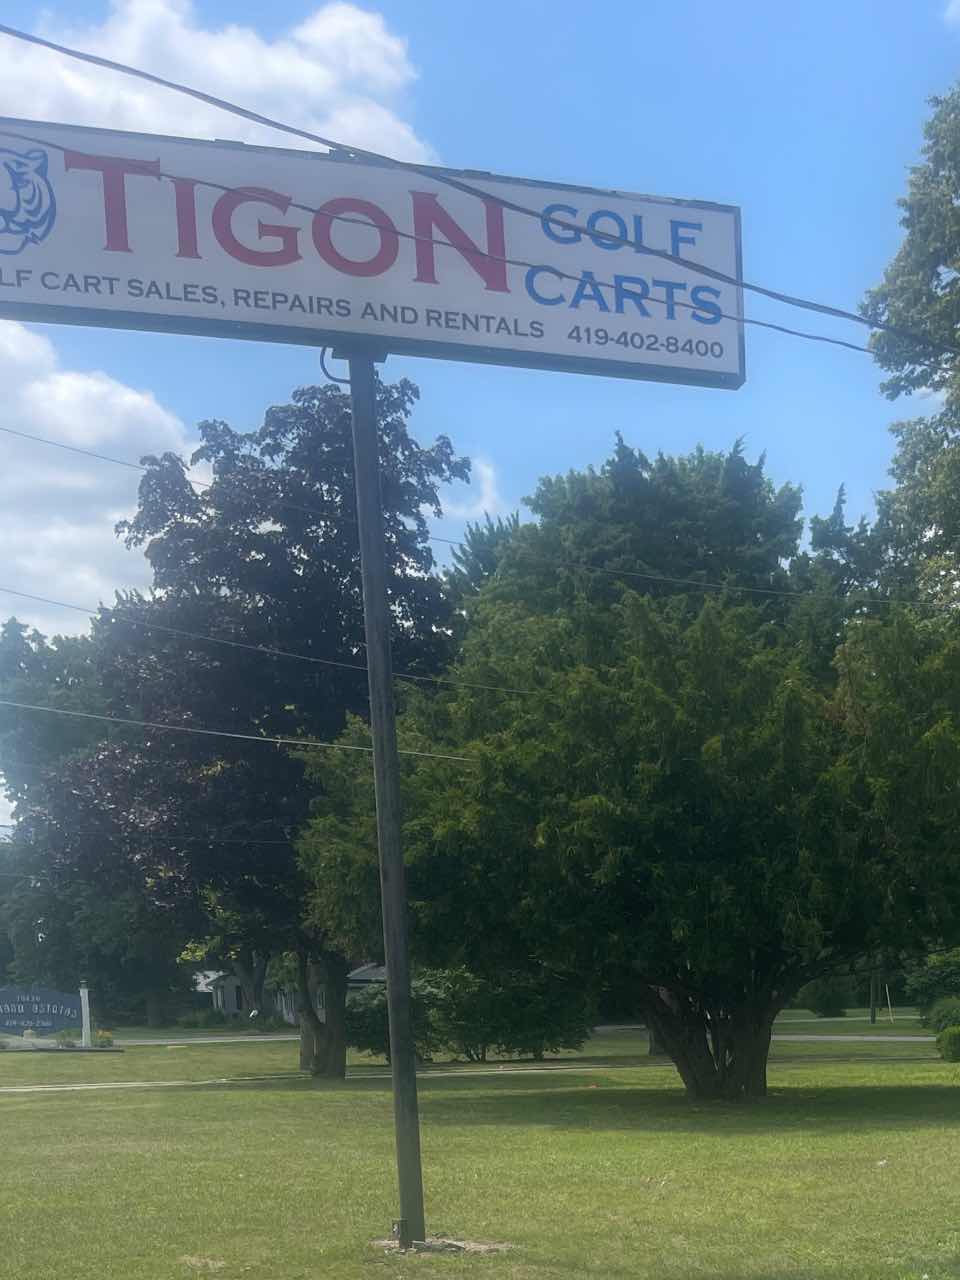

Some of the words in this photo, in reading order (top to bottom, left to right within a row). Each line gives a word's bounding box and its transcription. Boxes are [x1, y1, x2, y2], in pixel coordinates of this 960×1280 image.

[64, 150, 510, 292] TIGON
[541, 203, 702, 258] GOLF
[40, 271, 120, 296] CART
[127, 279, 225, 307] SALES,
[233, 288, 351, 318] REPAIRS
[360, 302, 419, 325] AND
[426, 309, 545, 339] RENTALS
[524, 265, 722, 325] CARTS
[567, 325, 724, 358] 419-402-8400
